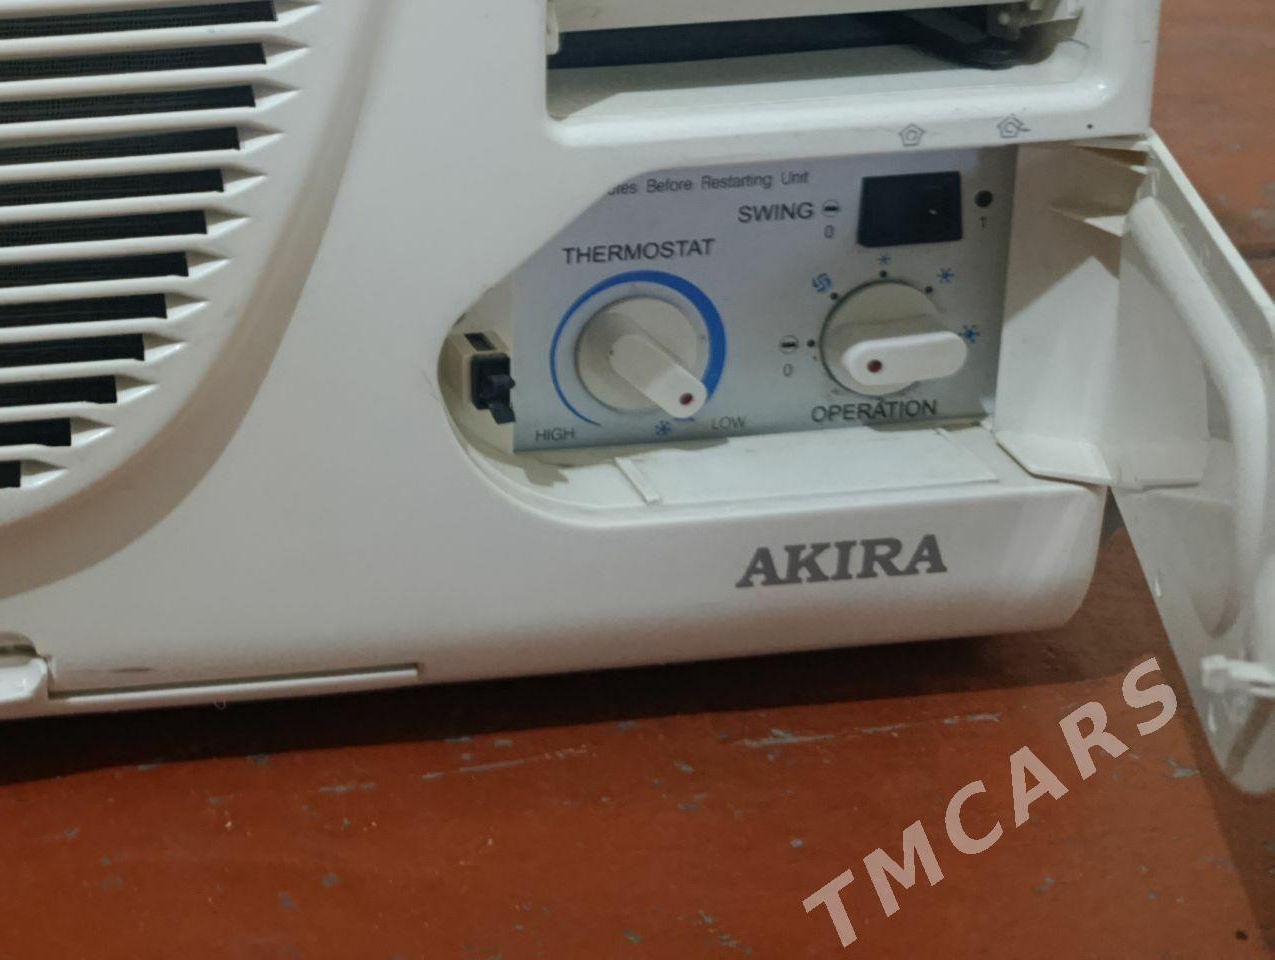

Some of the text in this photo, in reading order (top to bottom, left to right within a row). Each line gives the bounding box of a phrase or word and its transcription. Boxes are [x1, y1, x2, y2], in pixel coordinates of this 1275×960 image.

[646, 178, 693, 193] Before
[701, 174, 772, 190] Restarting
[780, 171, 810, 185] Unit
[737, 202, 814, 223] SWING
[562, 238, 716, 265] THERMOSTAT
[811, 399, 938, 423] OPERATION
[535, 427, 575, 442] HIGH
[711, 416, 747, 431] LOW
[735, 533, 948, 588] AKIRA
